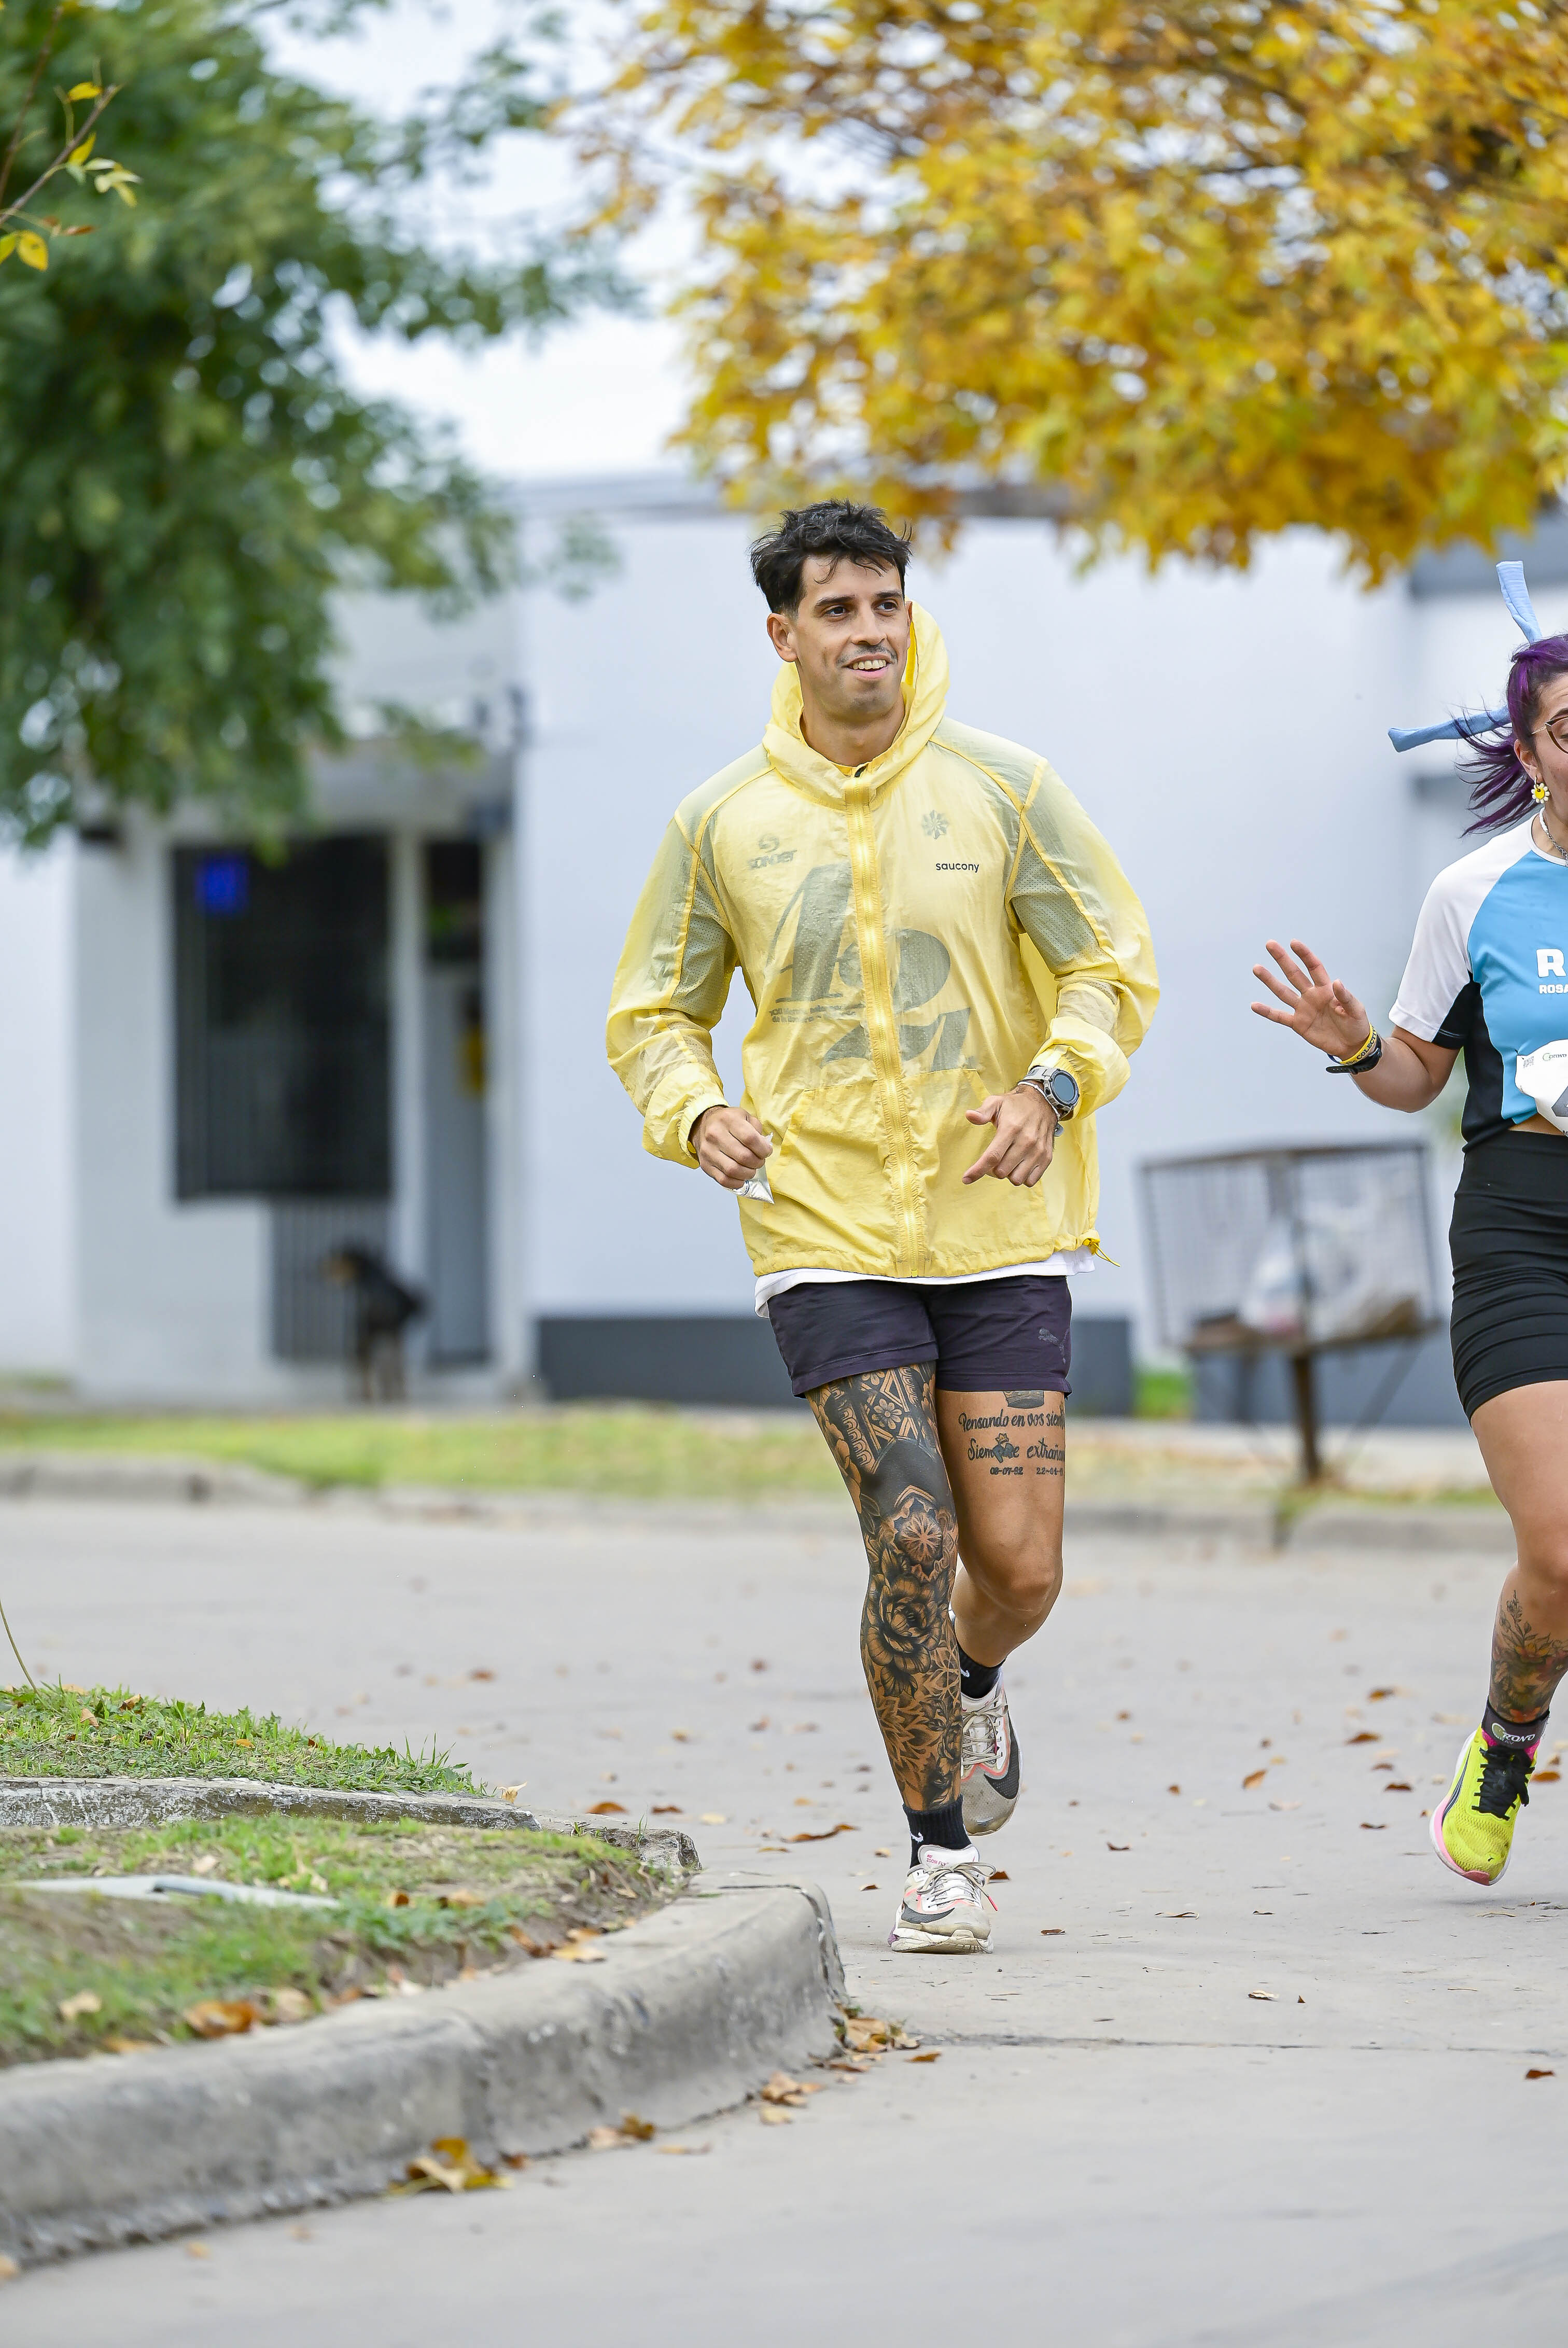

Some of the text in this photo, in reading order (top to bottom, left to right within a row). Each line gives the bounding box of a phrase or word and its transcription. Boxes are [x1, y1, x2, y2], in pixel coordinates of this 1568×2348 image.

[935, 863, 979, 873] saucony
[958, 1408, 1009, 1432] Pensando
[1011, 1414, 1026, 1427] en
[1027, 1412, 1044, 1427] vos
